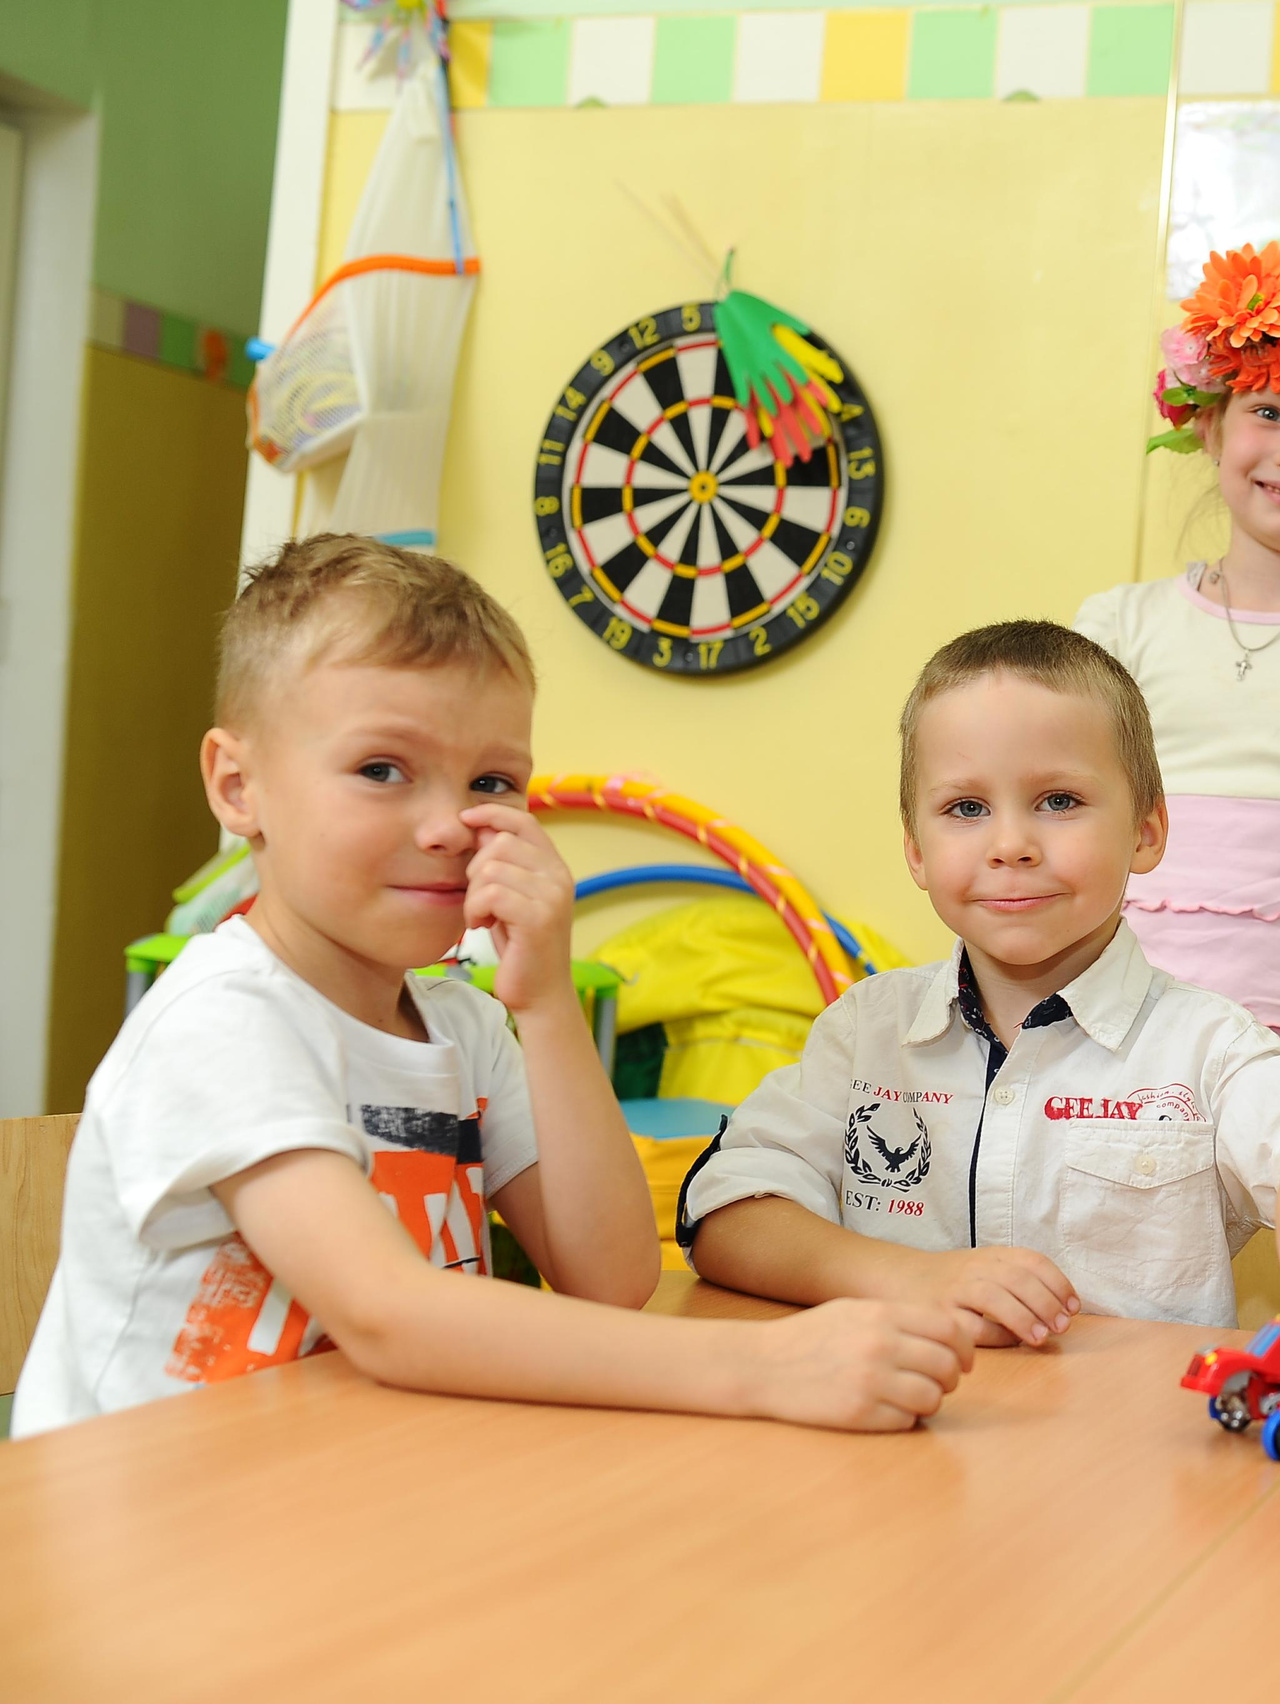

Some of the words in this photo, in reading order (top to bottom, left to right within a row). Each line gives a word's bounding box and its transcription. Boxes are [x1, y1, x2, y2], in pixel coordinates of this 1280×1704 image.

[628, 316, 660, 350] 12
[681, 304, 701, 332] 5
[590, 350, 615, 377] 9
[554, 386, 587, 422] 14
[538, 439, 566, 467] 11
[848, 446, 877, 480] 13
[534, 495, 560, 517] 8
[544, 542, 574, 579] 16
[821, 551, 853, 587] 10
[567, 585, 595, 608] 7
[786, 592, 820, 629] 15
[602, 616, 632, 650] 19
[750, 626, 772, 657] 2
[652, 637, 673, 668] 3
[697, 640, 724, 670] 17
[850, 1079, 872, 1094] EE
[873, 1086, 902, 1102] JAY
[1044, 1096, 1094, 1120] GEE
[845, 1190, 881, 1211] EST:
[888, 1199, 924, 1217] 1988
